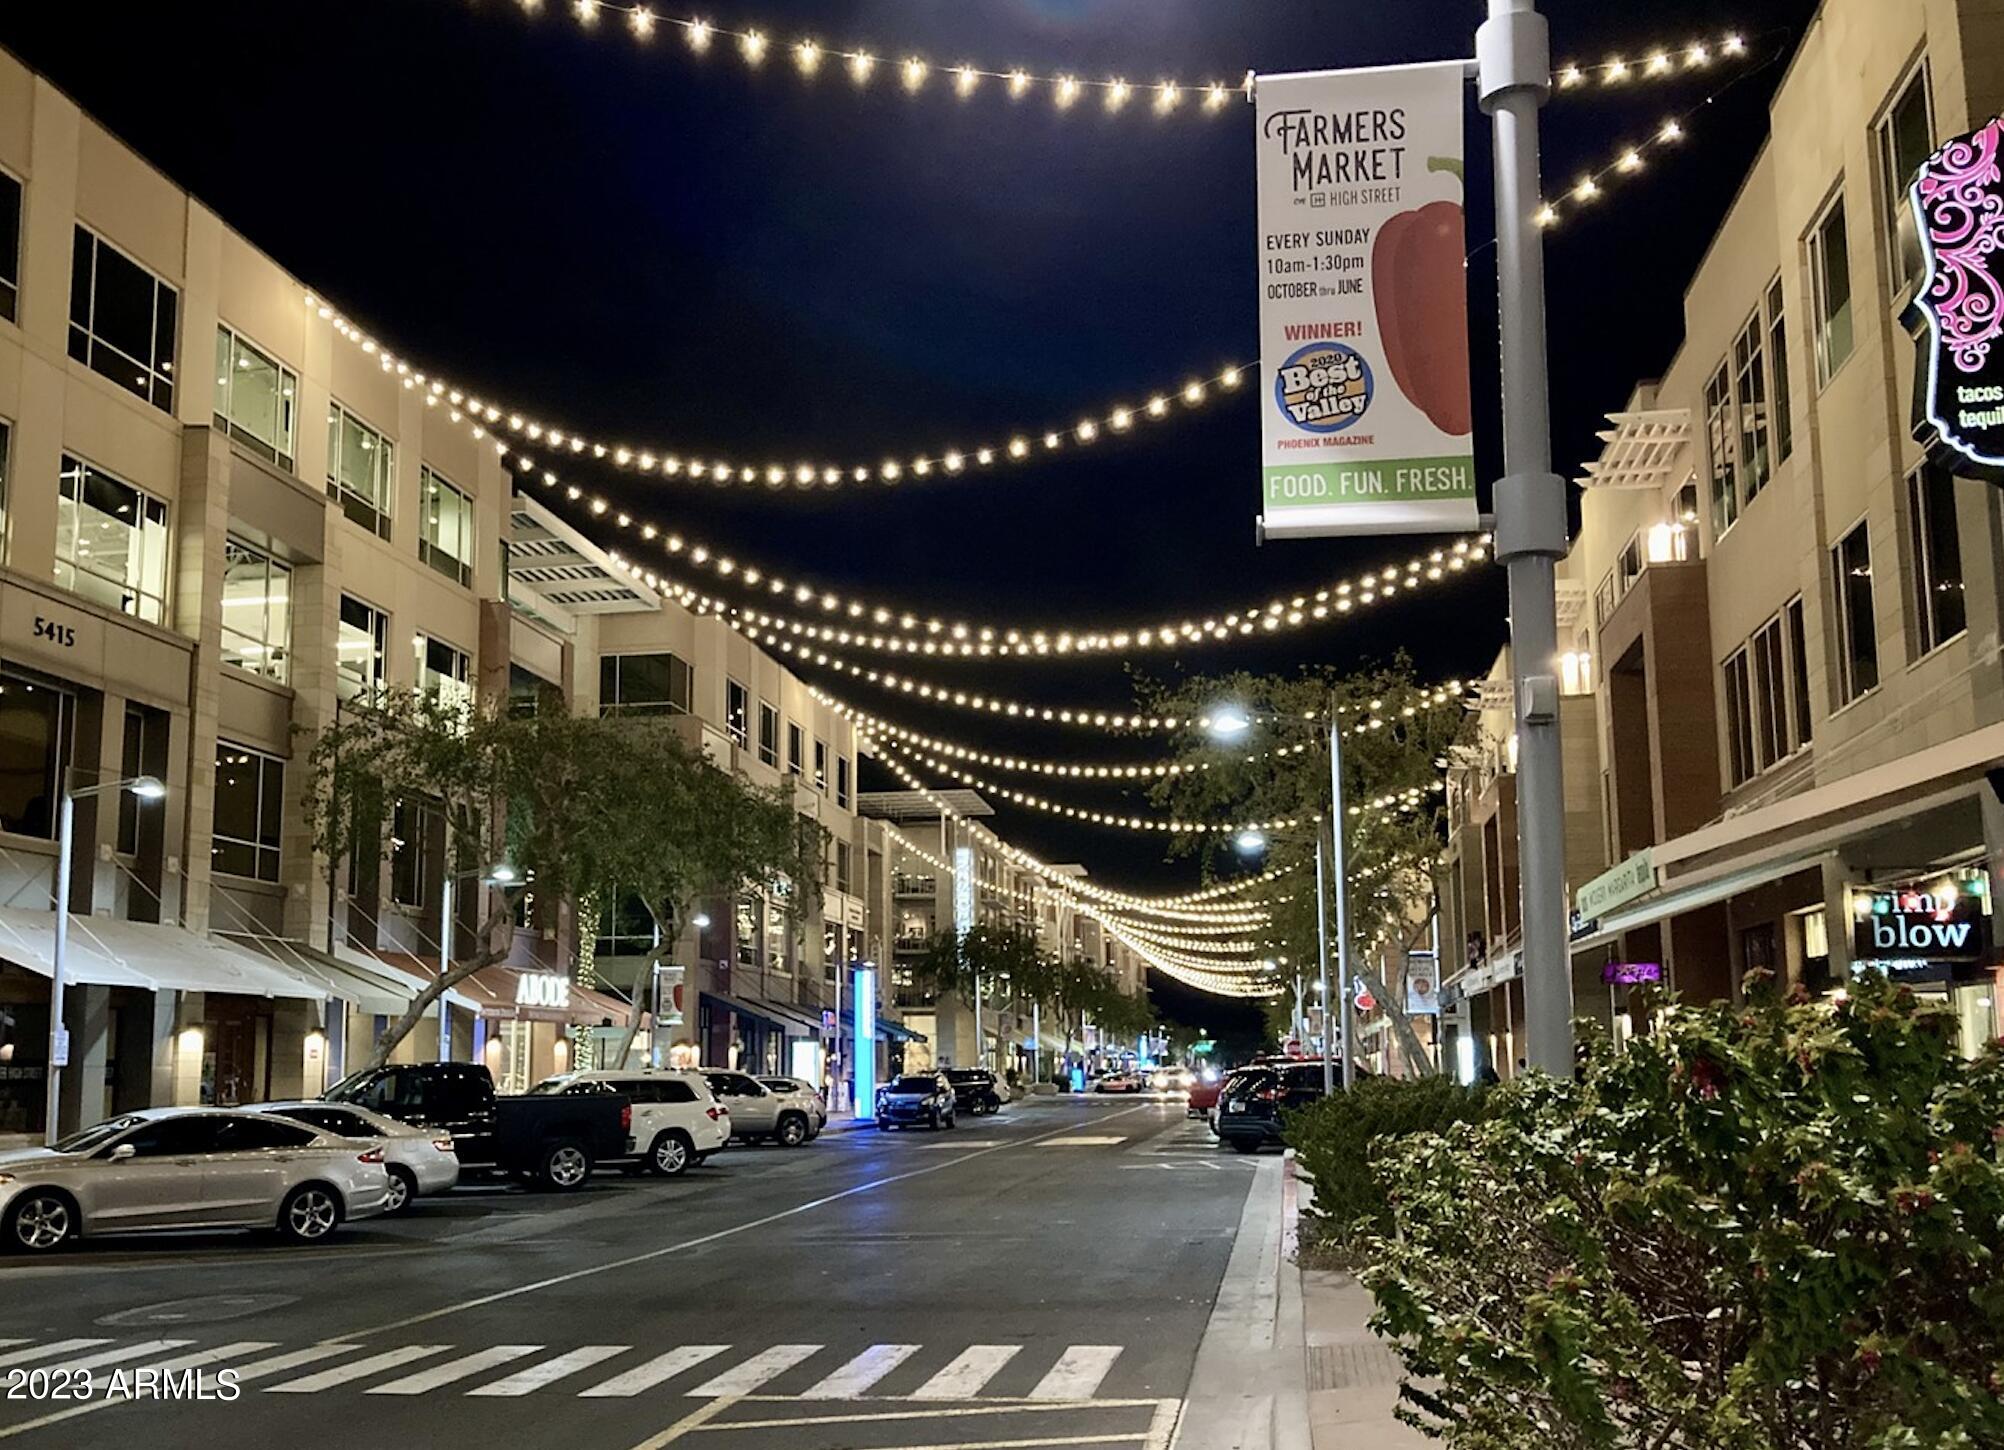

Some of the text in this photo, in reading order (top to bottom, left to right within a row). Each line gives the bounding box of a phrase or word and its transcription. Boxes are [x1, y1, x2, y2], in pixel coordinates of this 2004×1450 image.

[1264, 109, 1405, 154] FARMERS
[1293, 148, 1405, 191] MARKET
[1330, 190, 1358, 206] HIGH
[1361, 187, 1401, 204] STREET
[1266, 228, 1370, 250] EVERY SUNDAY
[1267, 254, 1364, 274] 10am-1:30pm
[1267, 282, 1317, 299] OCTOBER
[1337, 278, 1363, 295] JUNE
[1284, 321, 1362, 341] WINNER!
[1310, 353, 1342, 368] 2020
[1279, 354, 1361, 395] Best
[1305, 384, 1345, 402] of the
[1956, 385, 2004, 403] tacos
[1286, 394, 1367, 423] Valley
[1277, 435, 1375, 449] PHOENIX MAGAZINE
[1269, 467, 1473, 499] FOOD. FUN. FRESH.
[33, 616, 75, 647] 5415
[1870, 915, 1971, 948] blow
